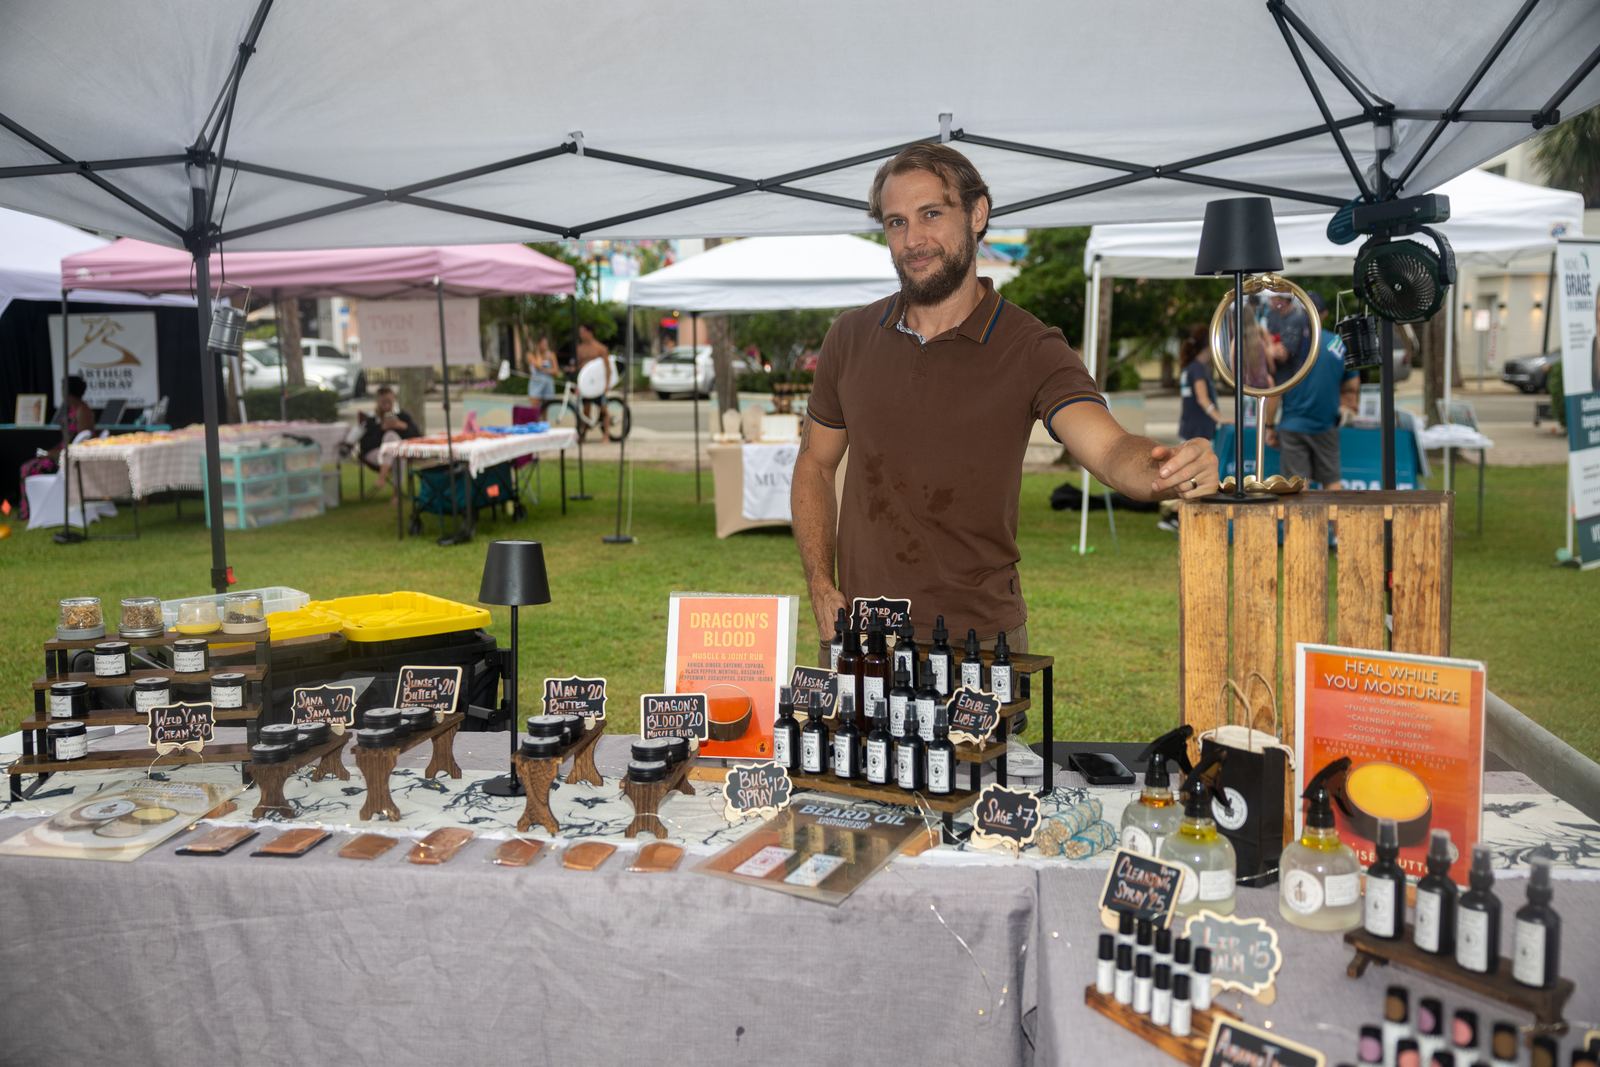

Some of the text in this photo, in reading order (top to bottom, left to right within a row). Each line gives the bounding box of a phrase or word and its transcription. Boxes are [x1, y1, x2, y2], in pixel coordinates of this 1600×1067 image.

[86, 380, 133, 390] URRAY
[690, 612, 769, 629] DRAGON'S
[704, 631, 756, 648] BLOOD
[403, 670, 440, 688] SUNSET
[794, 670, 830, 690] MASSAGE
[1345, 660, 1439, 685] HEAL WHILE
[403, 678, 456, 702] BUTTER $20
[550, 681, 577, 698] MAN
[1324, 673, 1460, 706] YOU MOISTURIZE
[297, 691, 323, 708] SANA
[550, 699, 589, 713] BUTTER
[648, 697, 699, 714] DRAGON'S
[957, 693, 991, 714] EDIBLE
[155, 708, 207, 726] WILD YAM
[305, 706, 331, 720] SANA
[646, 714, 684, 729] BLOOD
[953, 709, 976, 726] LUBE
[155, 726, 189, 741] CREAM
[739, 771, 768, 789] BUG
[738, 784, 775, 809] SPRAY
[799, 804, 871, 820] BEARD
[874, 813, 906, 826] OIL
[984, 798, 1035, 829] SAGE $7
[1114, 880, 1148, 907] SPRAY
[1204, 927, 1240, 950] LIP
